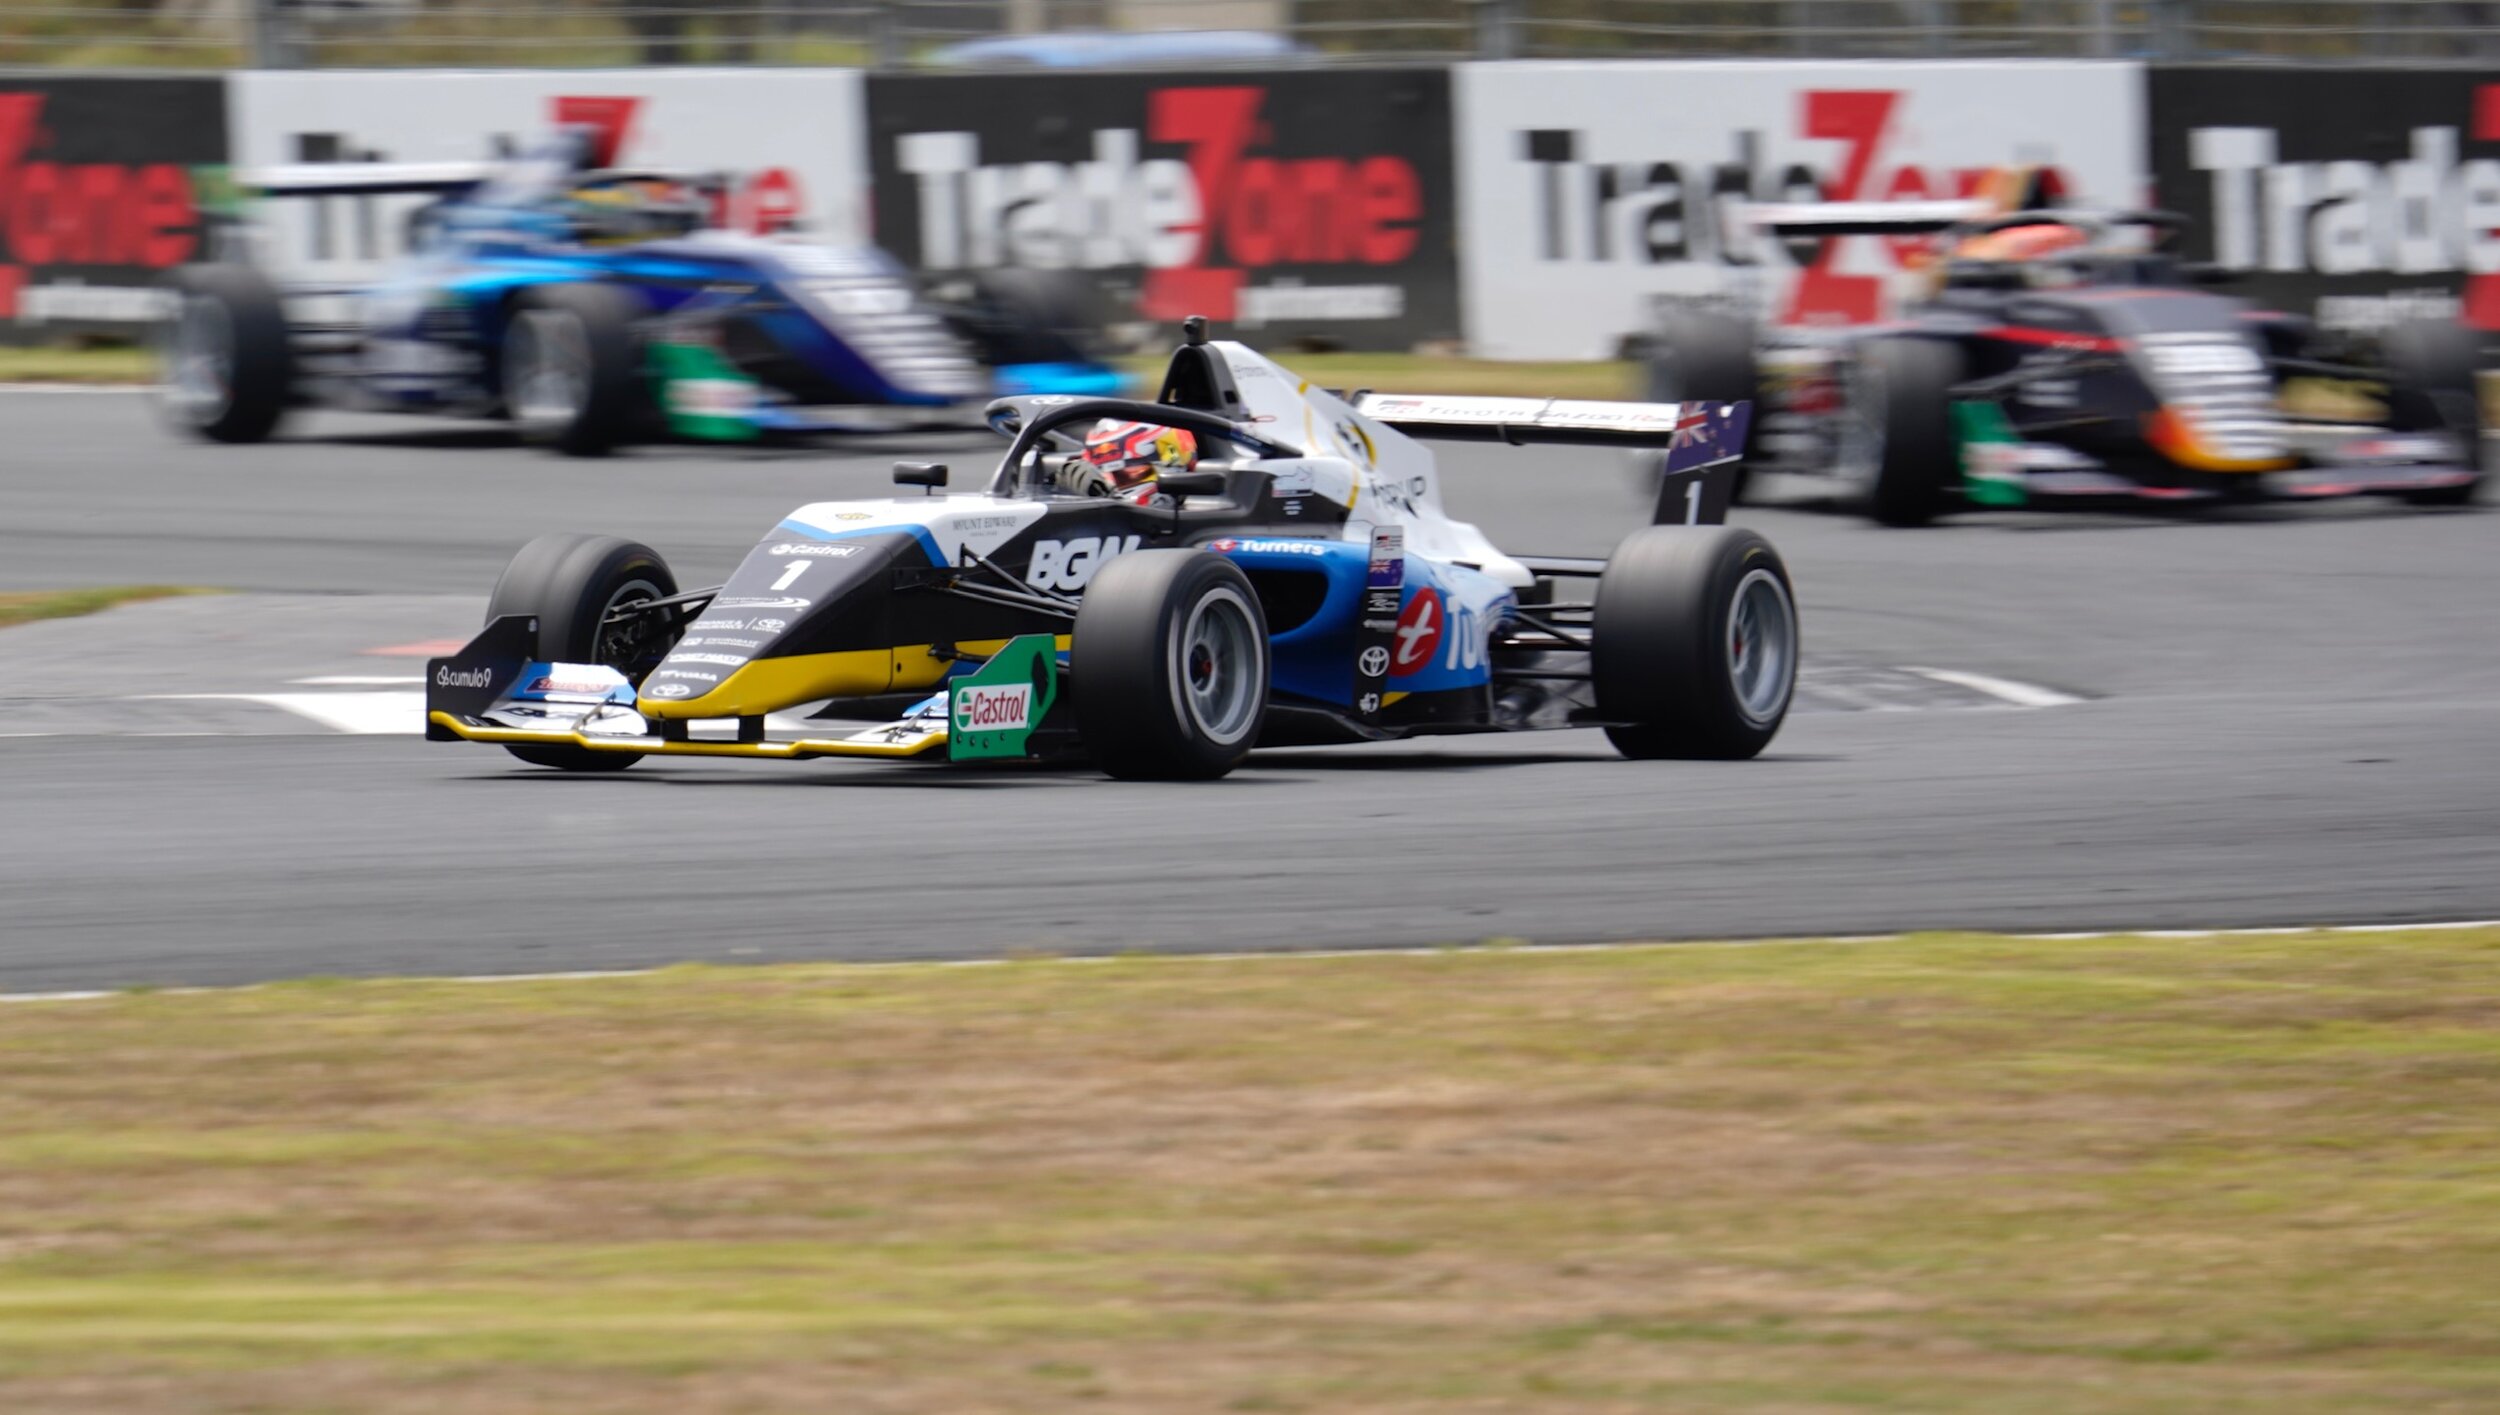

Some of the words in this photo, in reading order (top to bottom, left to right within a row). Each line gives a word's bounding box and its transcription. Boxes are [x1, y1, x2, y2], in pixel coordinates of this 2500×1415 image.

[2187, 84, 2500, 330] Trade
[1684, 480, 1702, 526] 1
[789, 544, 855, 556] Castrol
[1241, 539, 1325, 556] Turners
[769, 559, 813, 591] 1
[449, 667, 492, 688] cumulo9
[972, 690, 1026, 726] Castrol
